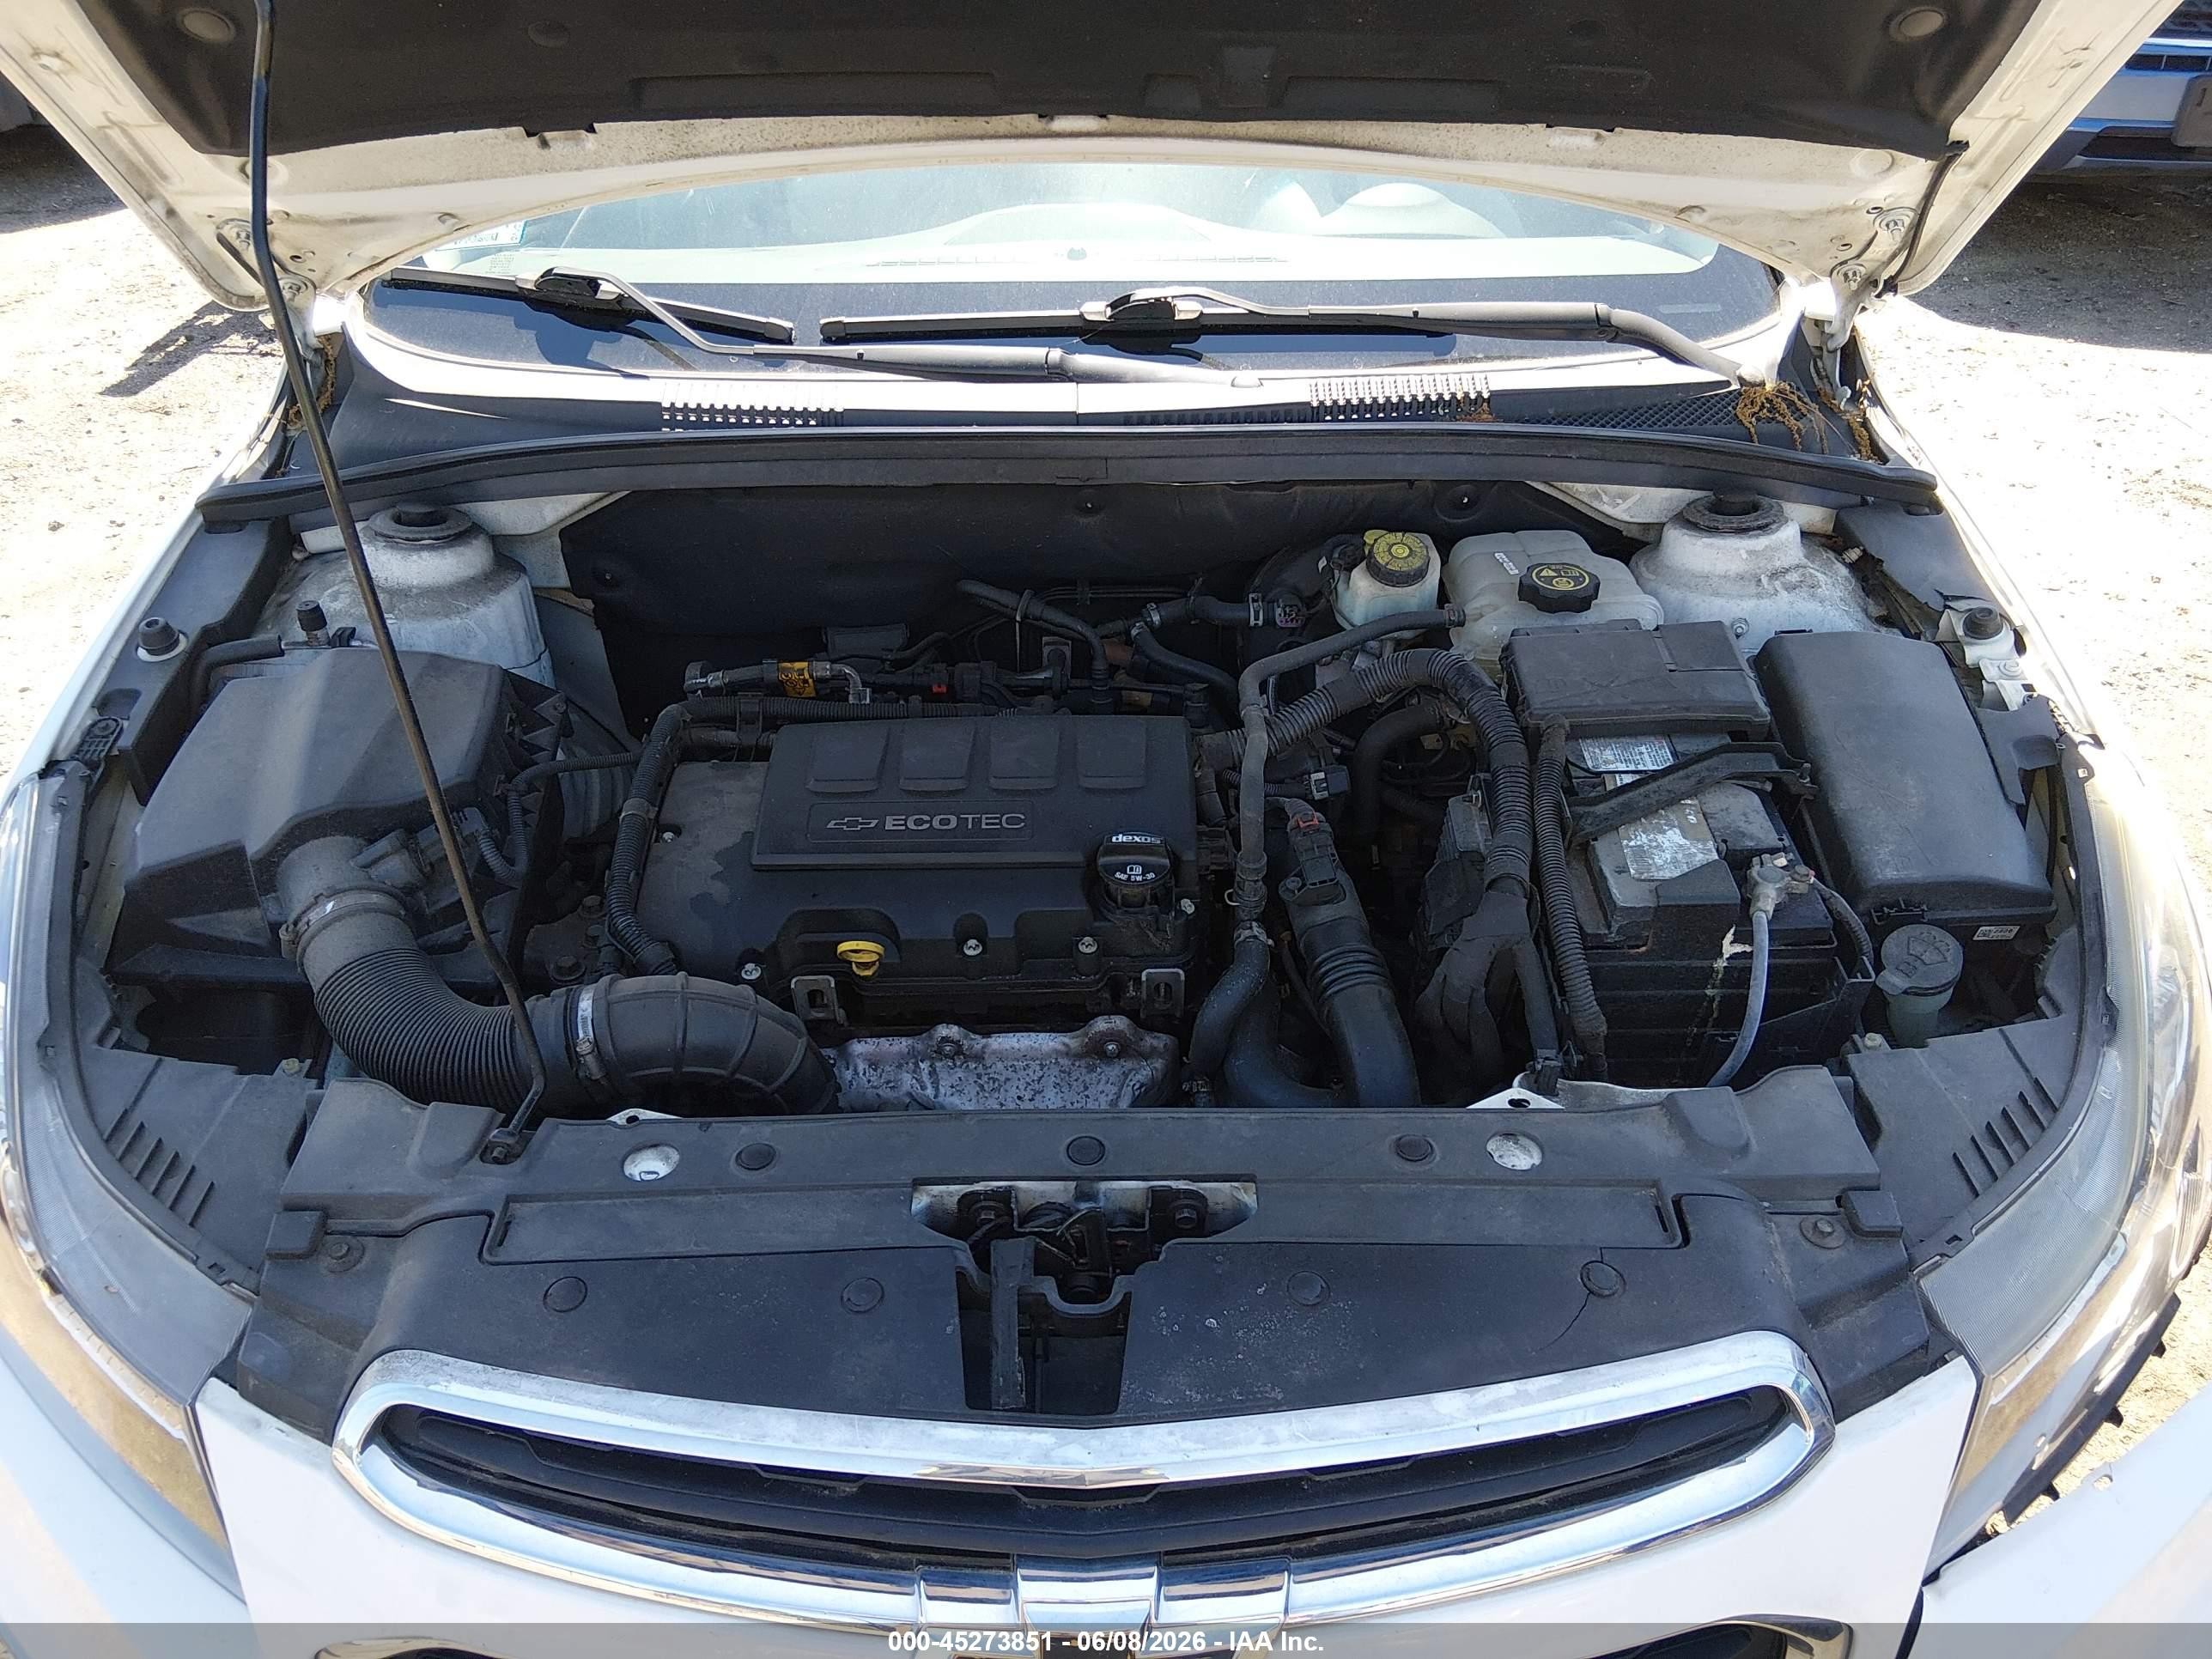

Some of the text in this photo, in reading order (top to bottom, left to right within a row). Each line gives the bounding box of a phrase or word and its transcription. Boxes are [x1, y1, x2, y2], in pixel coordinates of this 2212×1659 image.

[884, 813, 1026, 830] ECOTEC
[1111, 833, 1162, 844] dexos
[1114, 872, 1129, 881] SAE
